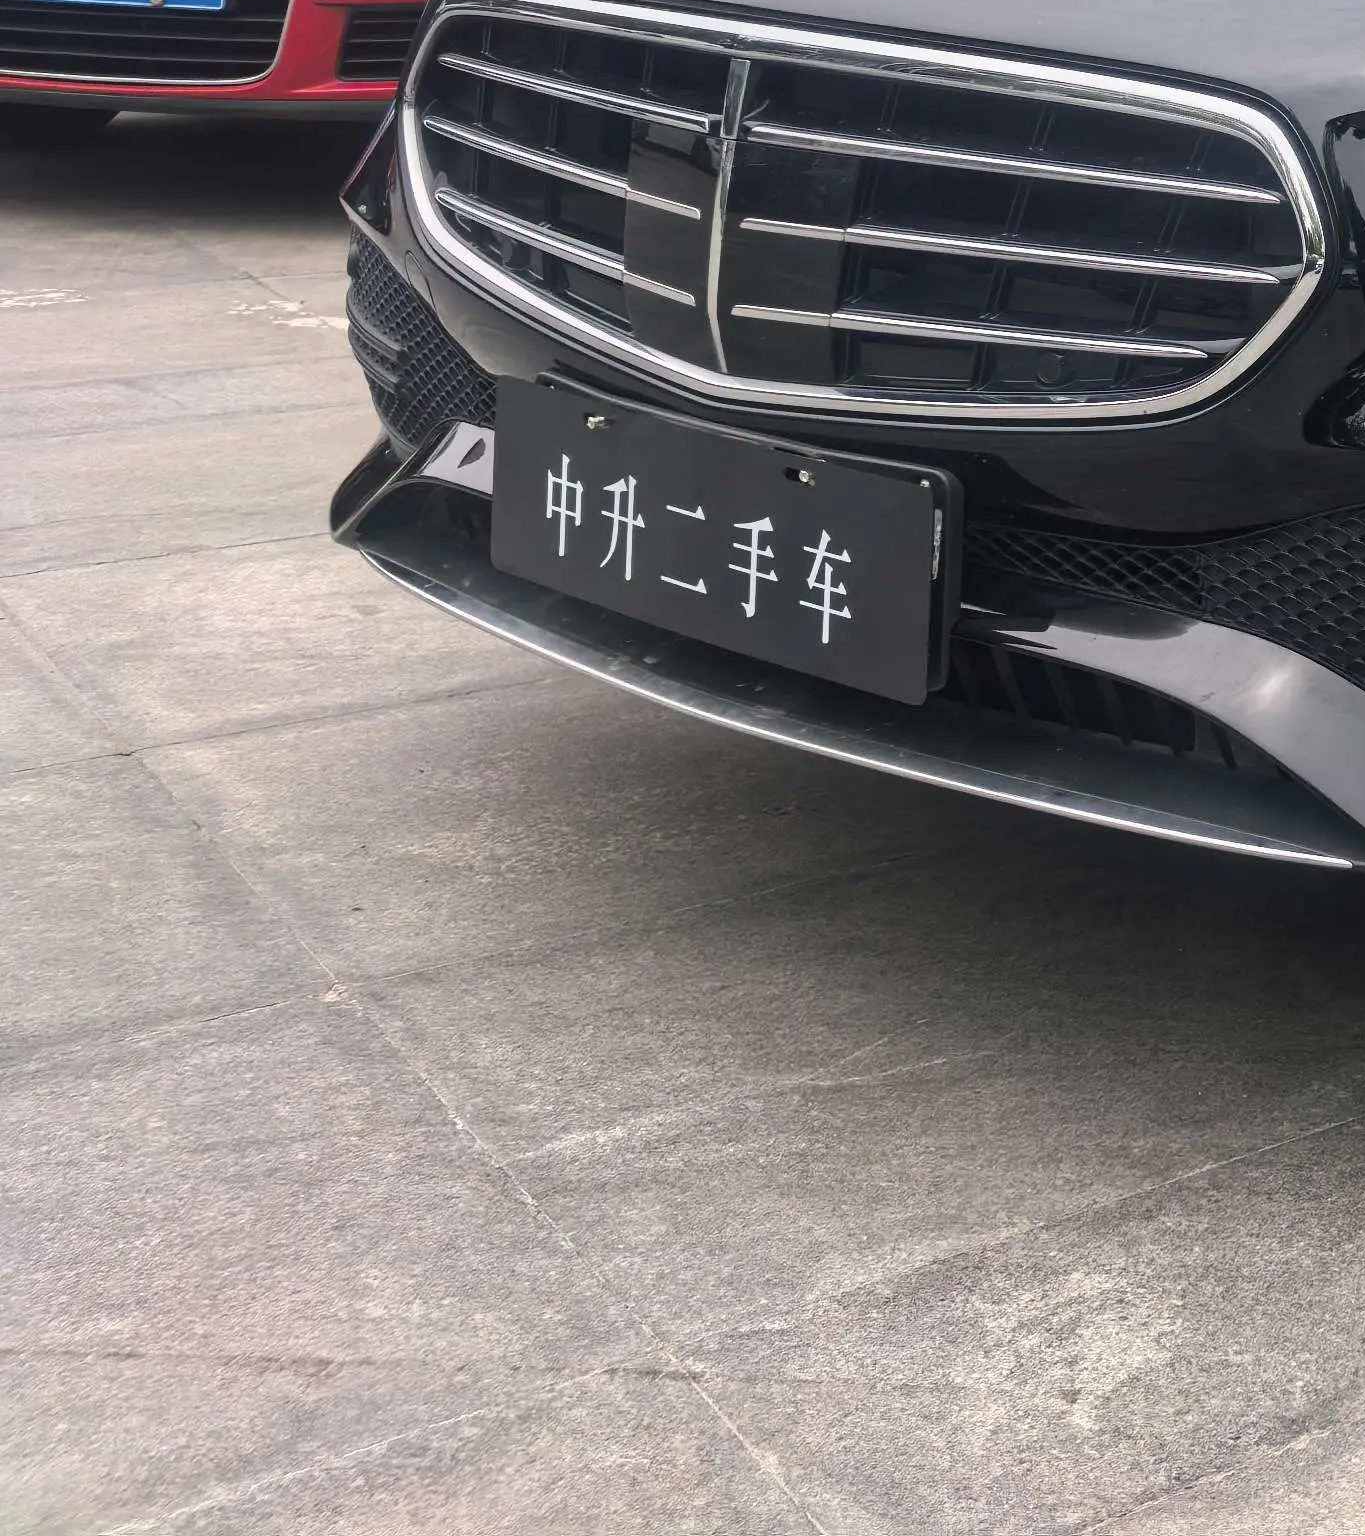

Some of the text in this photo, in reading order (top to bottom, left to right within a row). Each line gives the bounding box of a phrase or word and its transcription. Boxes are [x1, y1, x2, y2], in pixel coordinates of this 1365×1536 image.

[546, 454, 852, 644] 中升二手车
